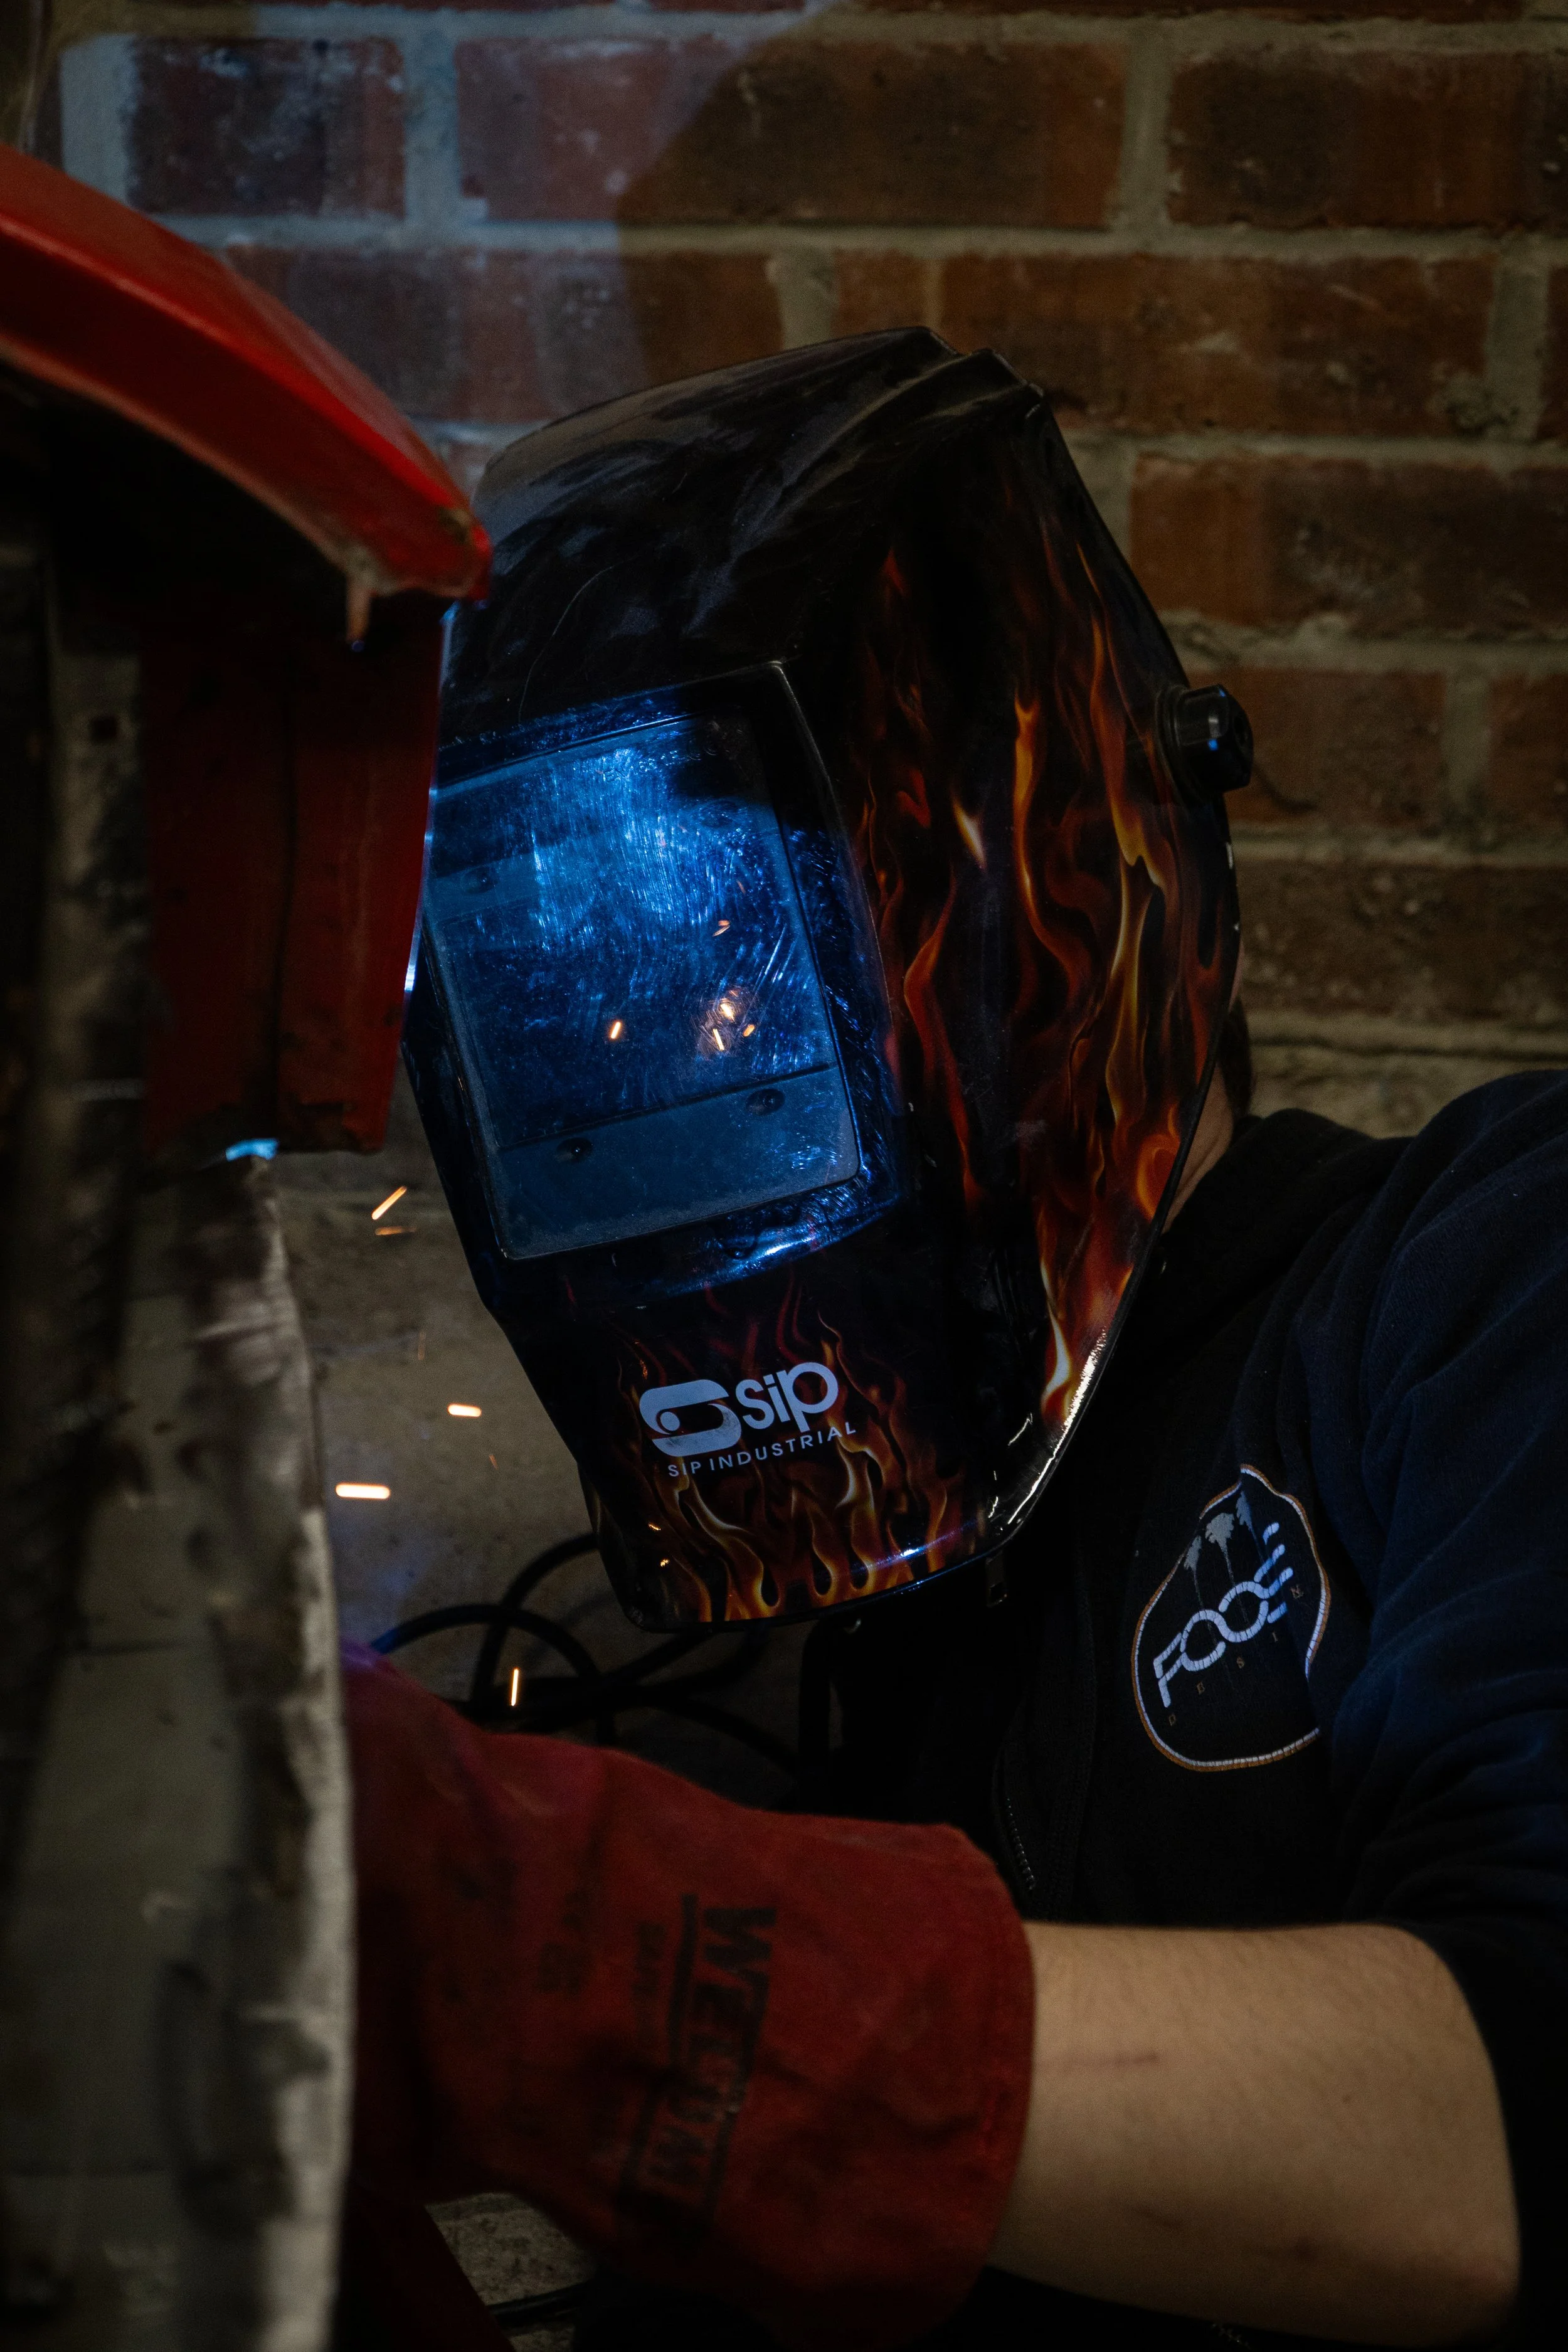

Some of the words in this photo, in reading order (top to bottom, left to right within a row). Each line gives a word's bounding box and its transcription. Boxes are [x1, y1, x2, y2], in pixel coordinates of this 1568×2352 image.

[735, 1362, 839, 1433] sip
[668, 1460, 702, 1478] SIP
[709, 1421, 857, 1472] INDUSTRIAL
